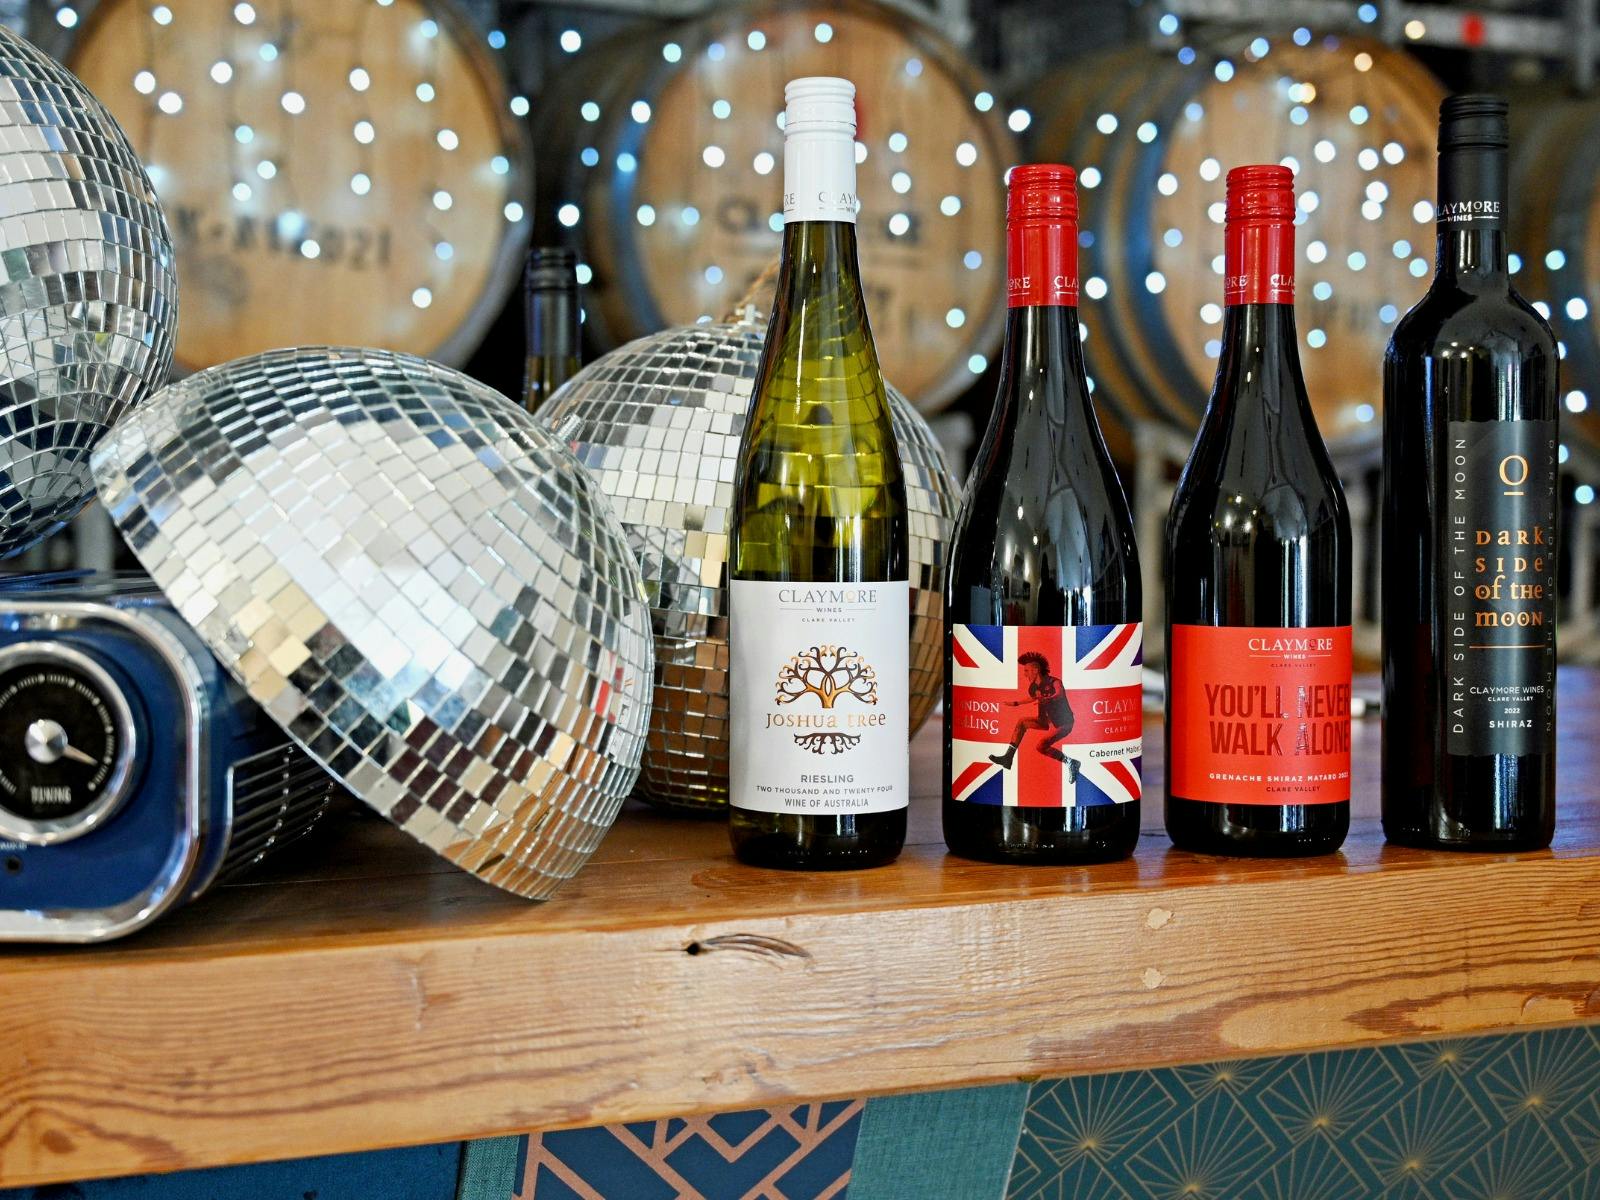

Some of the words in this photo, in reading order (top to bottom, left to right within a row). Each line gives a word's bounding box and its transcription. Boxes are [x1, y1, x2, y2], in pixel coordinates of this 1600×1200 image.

[1447, 214, 1472, 222] WINES
[1455, 439, 1466, 500] MOON
[1454, 515, 1466, 554] THE
[1454, 572, 1465, 596] OF
[778, 589, 877, 603] CLAYMORE
[1453, 612, 1465, 661] SIDE
[1248, 638, 1333, 651] CLAYMORE
[1469, 686, 1520, 695] CLAYMORE
[1522, 685, 1545, 694] WINES
[961, 701, 1000, 713] NDON
[1204, 683, 1283, 719] YOU'LL
[1297, 684, 1351, 719] NEVER
[1453, 677, 1464, 733] DARK
[1489, 719, 1533, 728] SHIRAZ
[1209, 721, 1283, 756] WALK
[1294, 721, 1349, 756] ALONE
[1089, 748, 1124, 758] Cabernet
[800, 774, 854, 783] RIESLING
[1209, 773, 1262, 782] GRENACHE
[1307, 774, 1336, 782] MATARO
[31, 786, 72, 804] TUNING
[756, 785, 773, 793] TWO
[775, 787, 819, 795] THOUSAND
[844, 786, 875, 795] TWENTY
[784, 798, 806, 808] WINE
[809, 799, 821, 807] OF
[824, 798, 869, 808] AUSTRALIA
